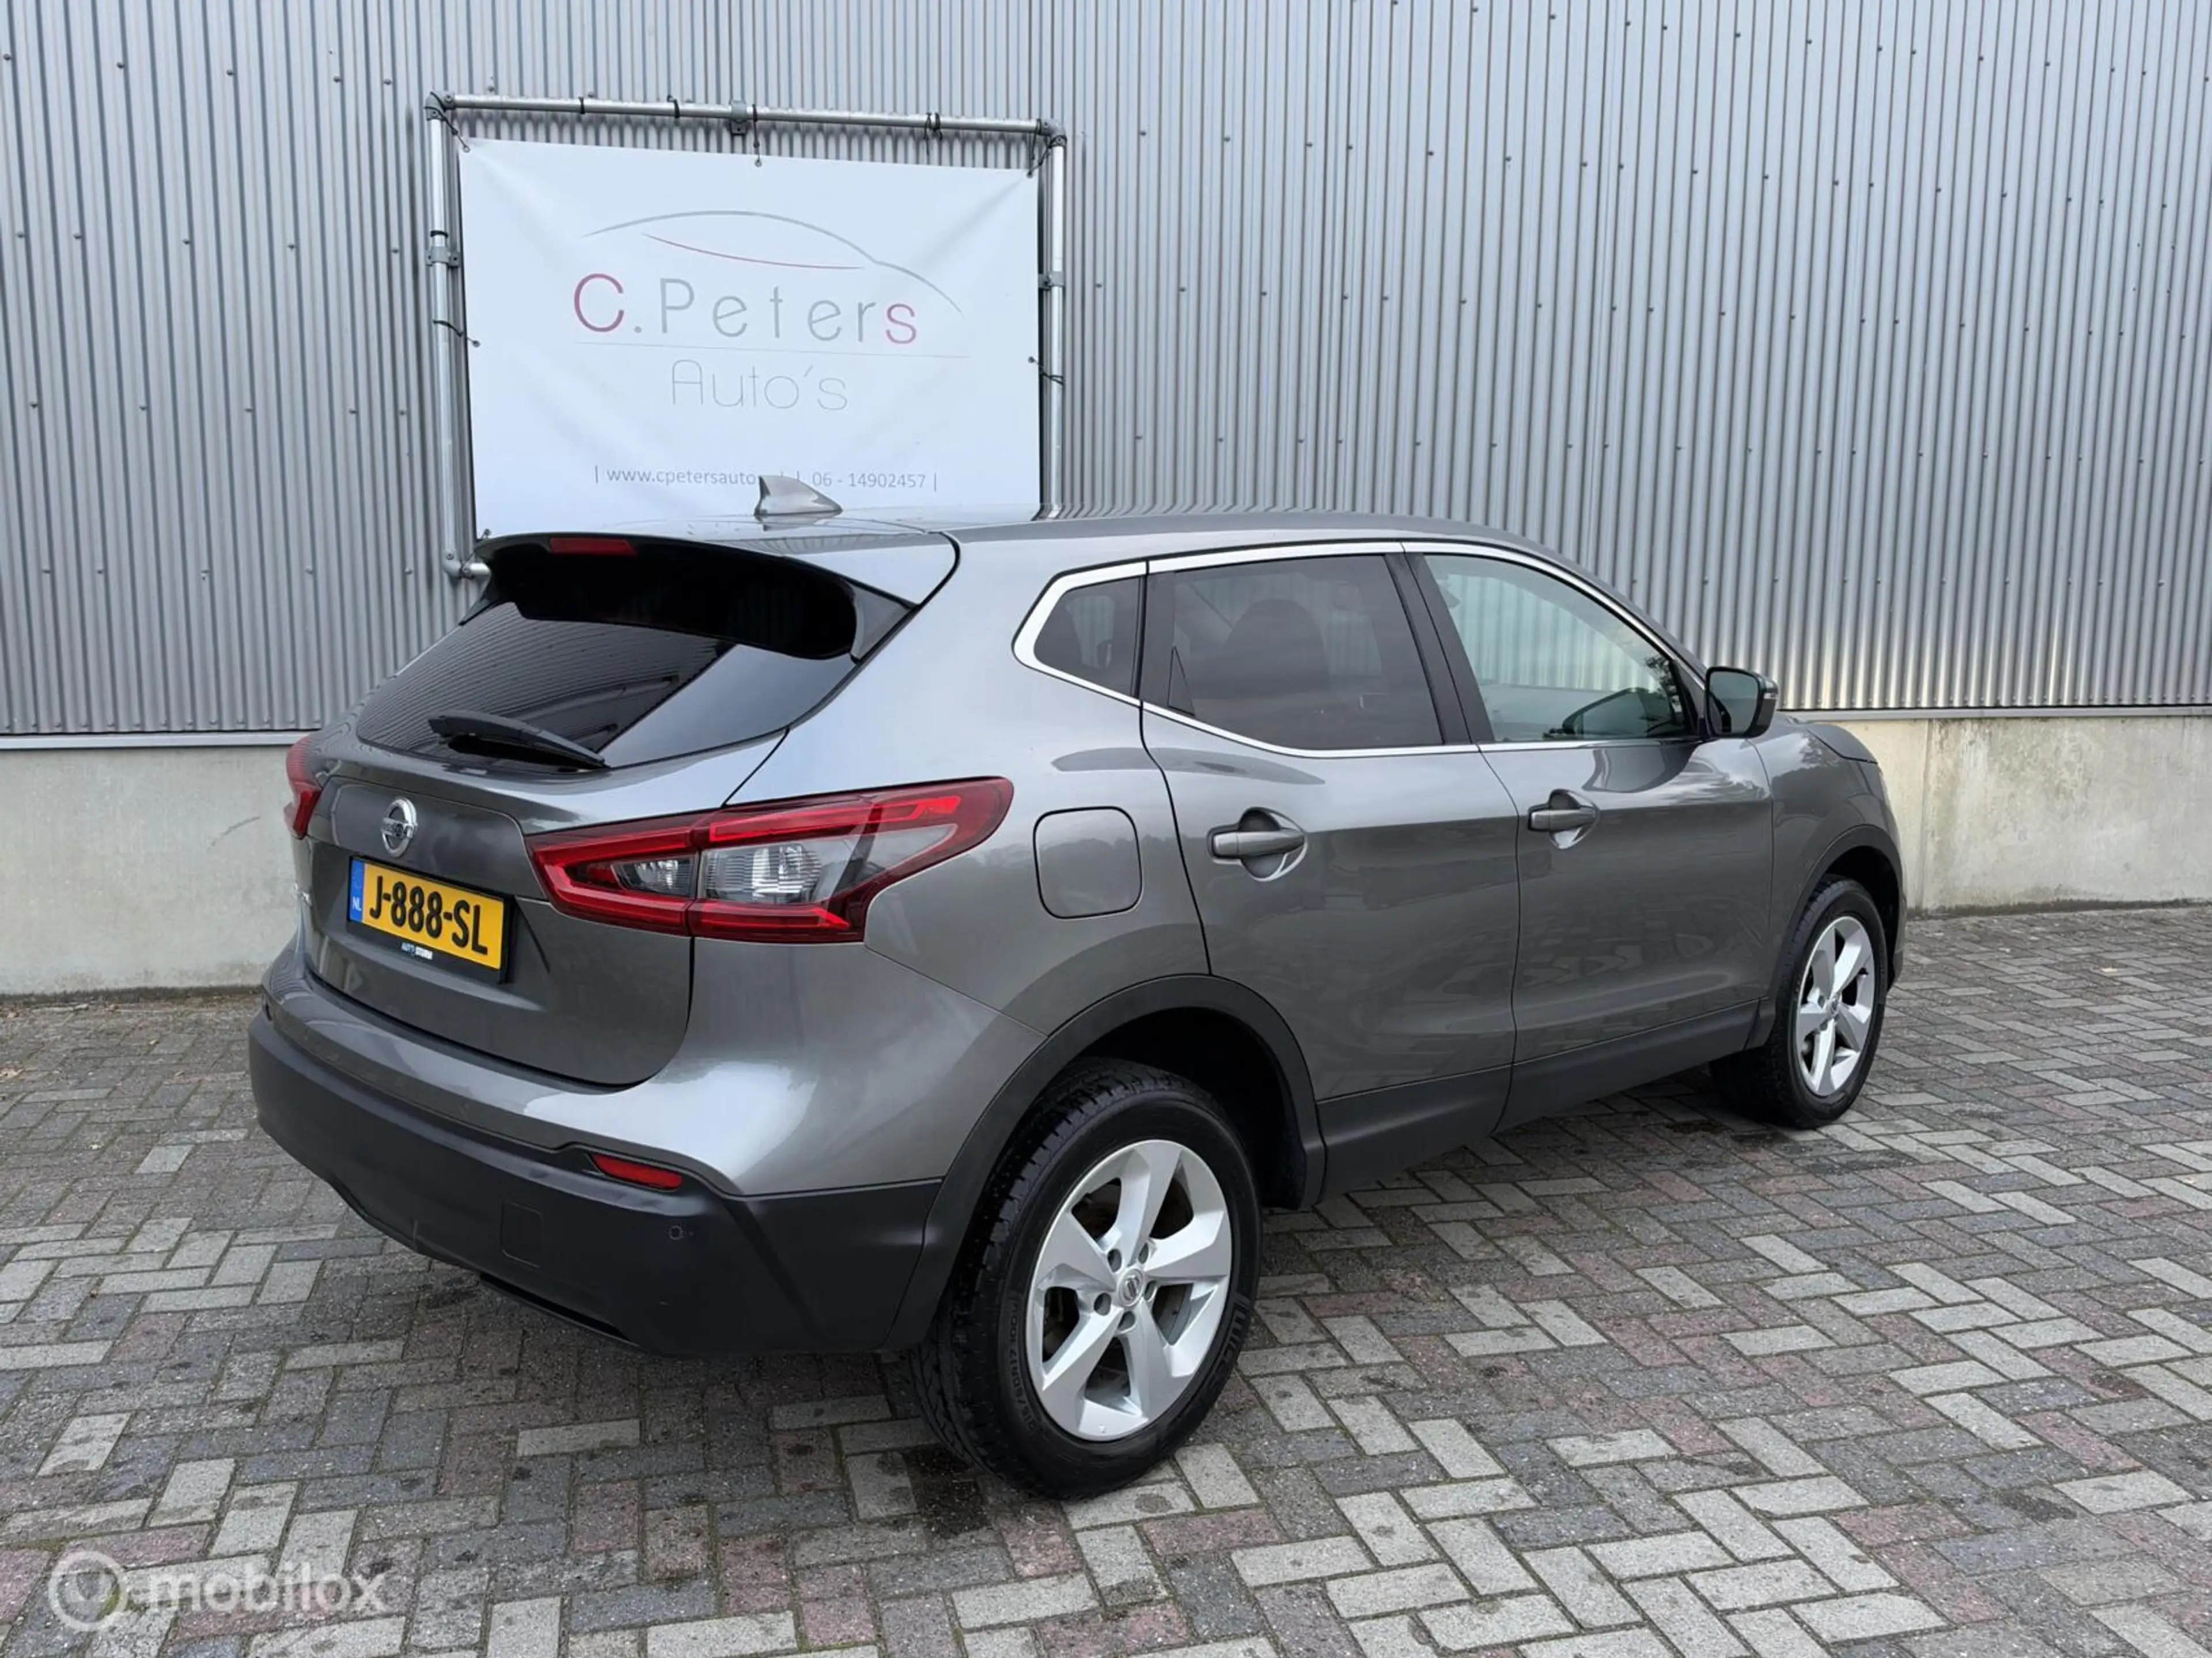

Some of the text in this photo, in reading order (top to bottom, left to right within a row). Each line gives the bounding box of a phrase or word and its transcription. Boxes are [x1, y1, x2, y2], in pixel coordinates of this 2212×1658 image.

[607, 469, 783, 486] www.cpetersauto
[812, 471, 832, 487] 06
[848, 472, 926, 488] 14902457
[352, 898, 362, 912] NL
[369, 875, 488, 956] J-888-SL
